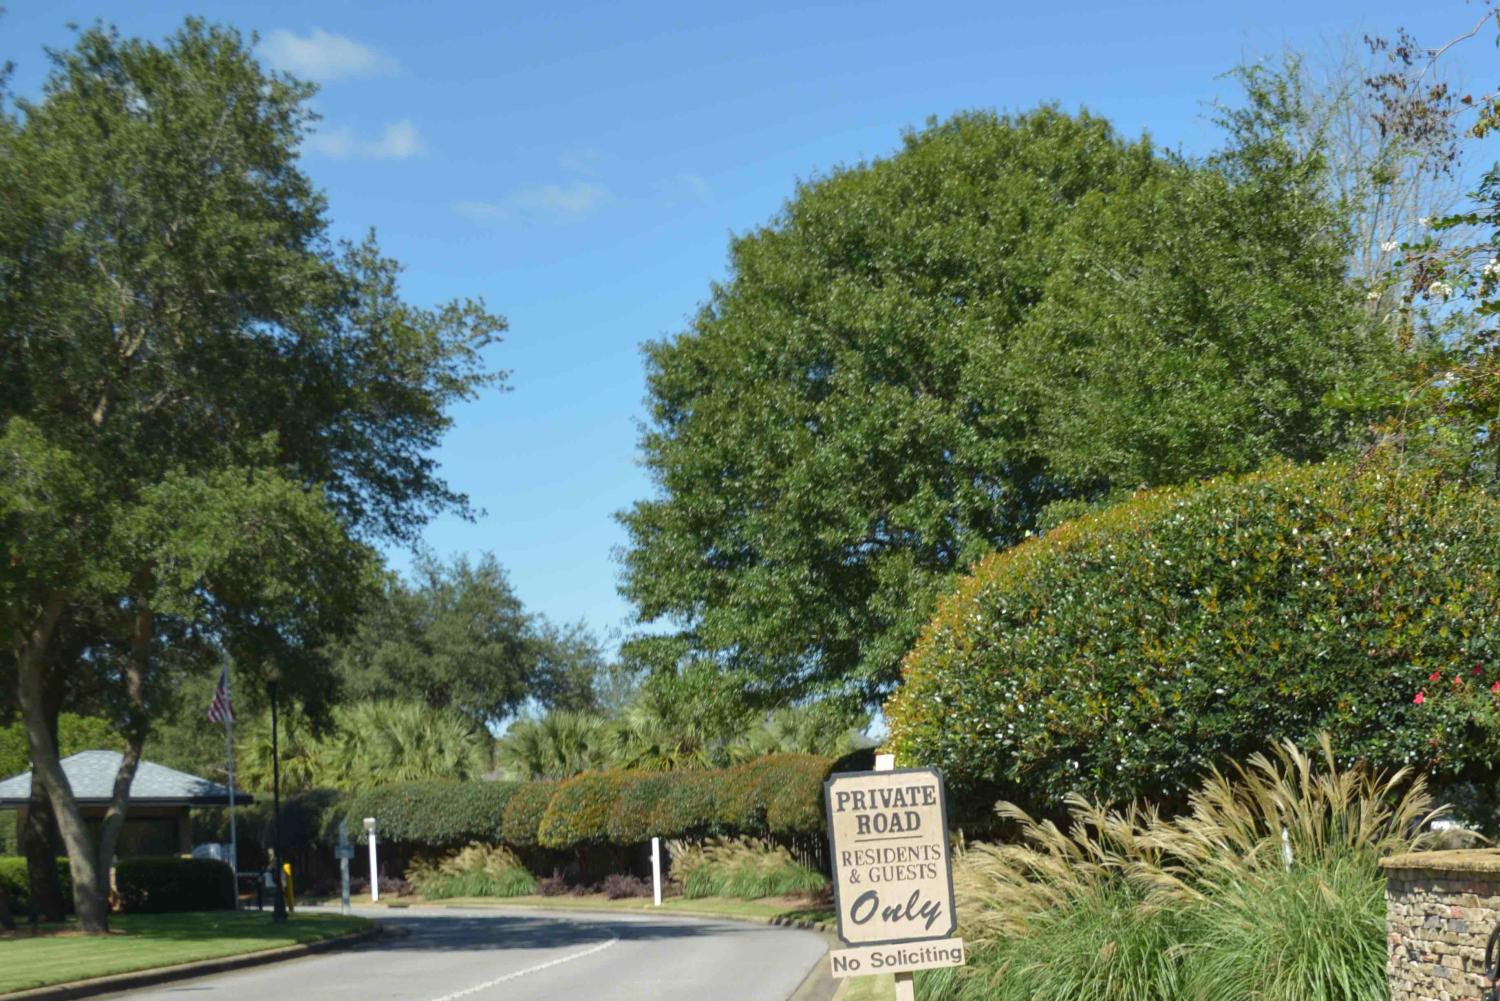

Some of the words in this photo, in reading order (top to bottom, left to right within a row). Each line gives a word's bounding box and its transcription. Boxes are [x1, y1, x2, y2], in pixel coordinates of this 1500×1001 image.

[836, 785, 936, 812] PRIVATE
[856, 811, 921, 835] ROAD
[842, 844, 941, 867] RESIDENTS
[849, 868, 861, 884] &
[869, 864, 937, 883] GUESTS
[850, 889, 941, 930] Only
[833, 955, 860, 972] No
[871, 946, 963, 968] Soliciting
